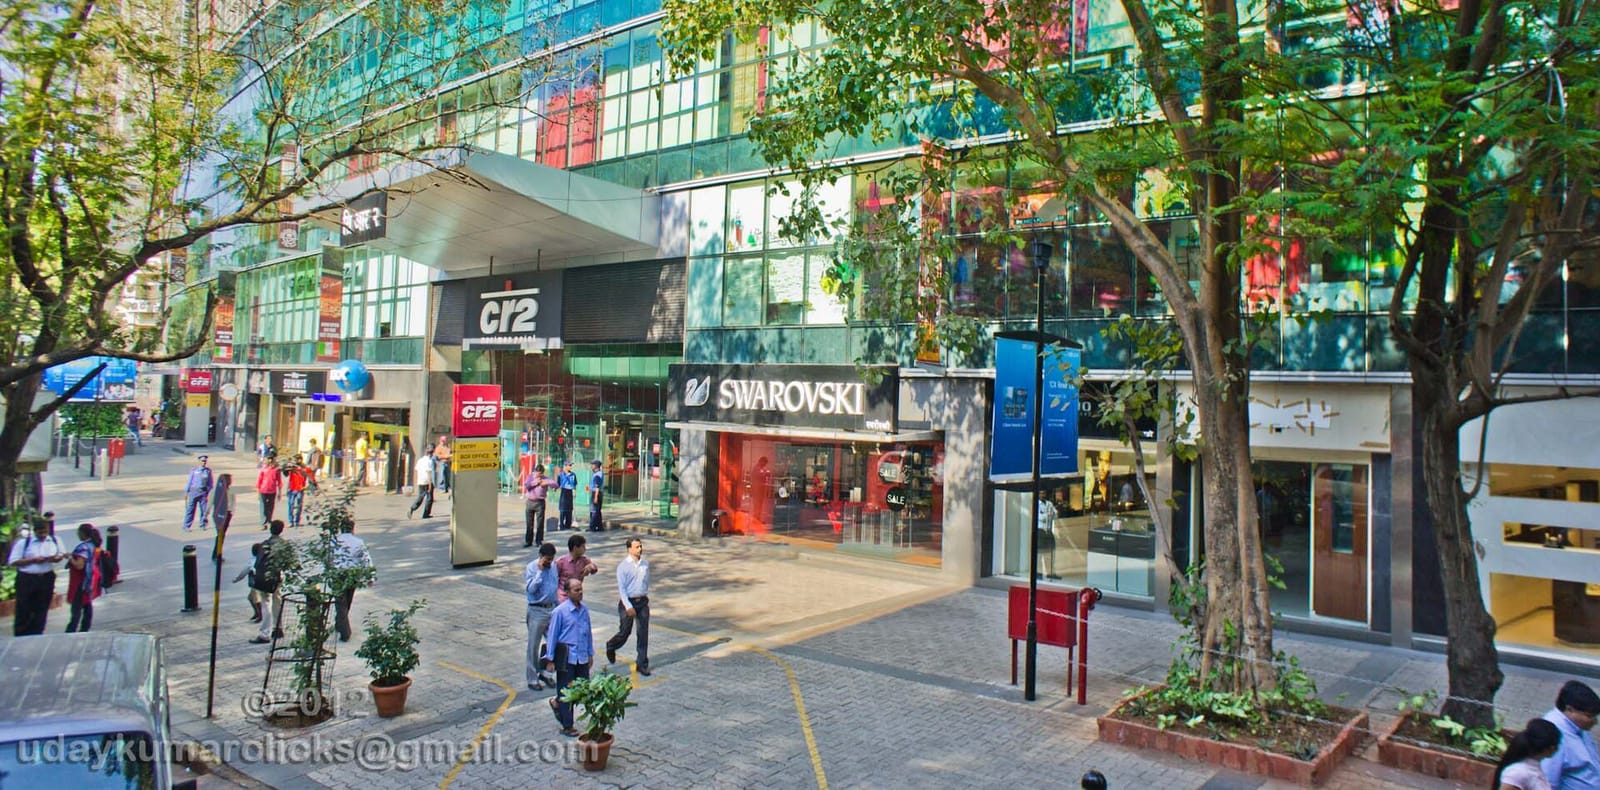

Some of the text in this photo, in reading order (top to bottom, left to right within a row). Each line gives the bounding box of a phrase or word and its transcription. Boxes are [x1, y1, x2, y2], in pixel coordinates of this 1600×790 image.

[480, 297, 539, 335] cr2
[719, 379, 866, 416] SWAROVSKI
[462, 405, 498, 419] cr2
[471, 452, 490, 460] OFFICE
[879, 466, 897, 479] SALE
[886, 493, 906, 506] SALE
